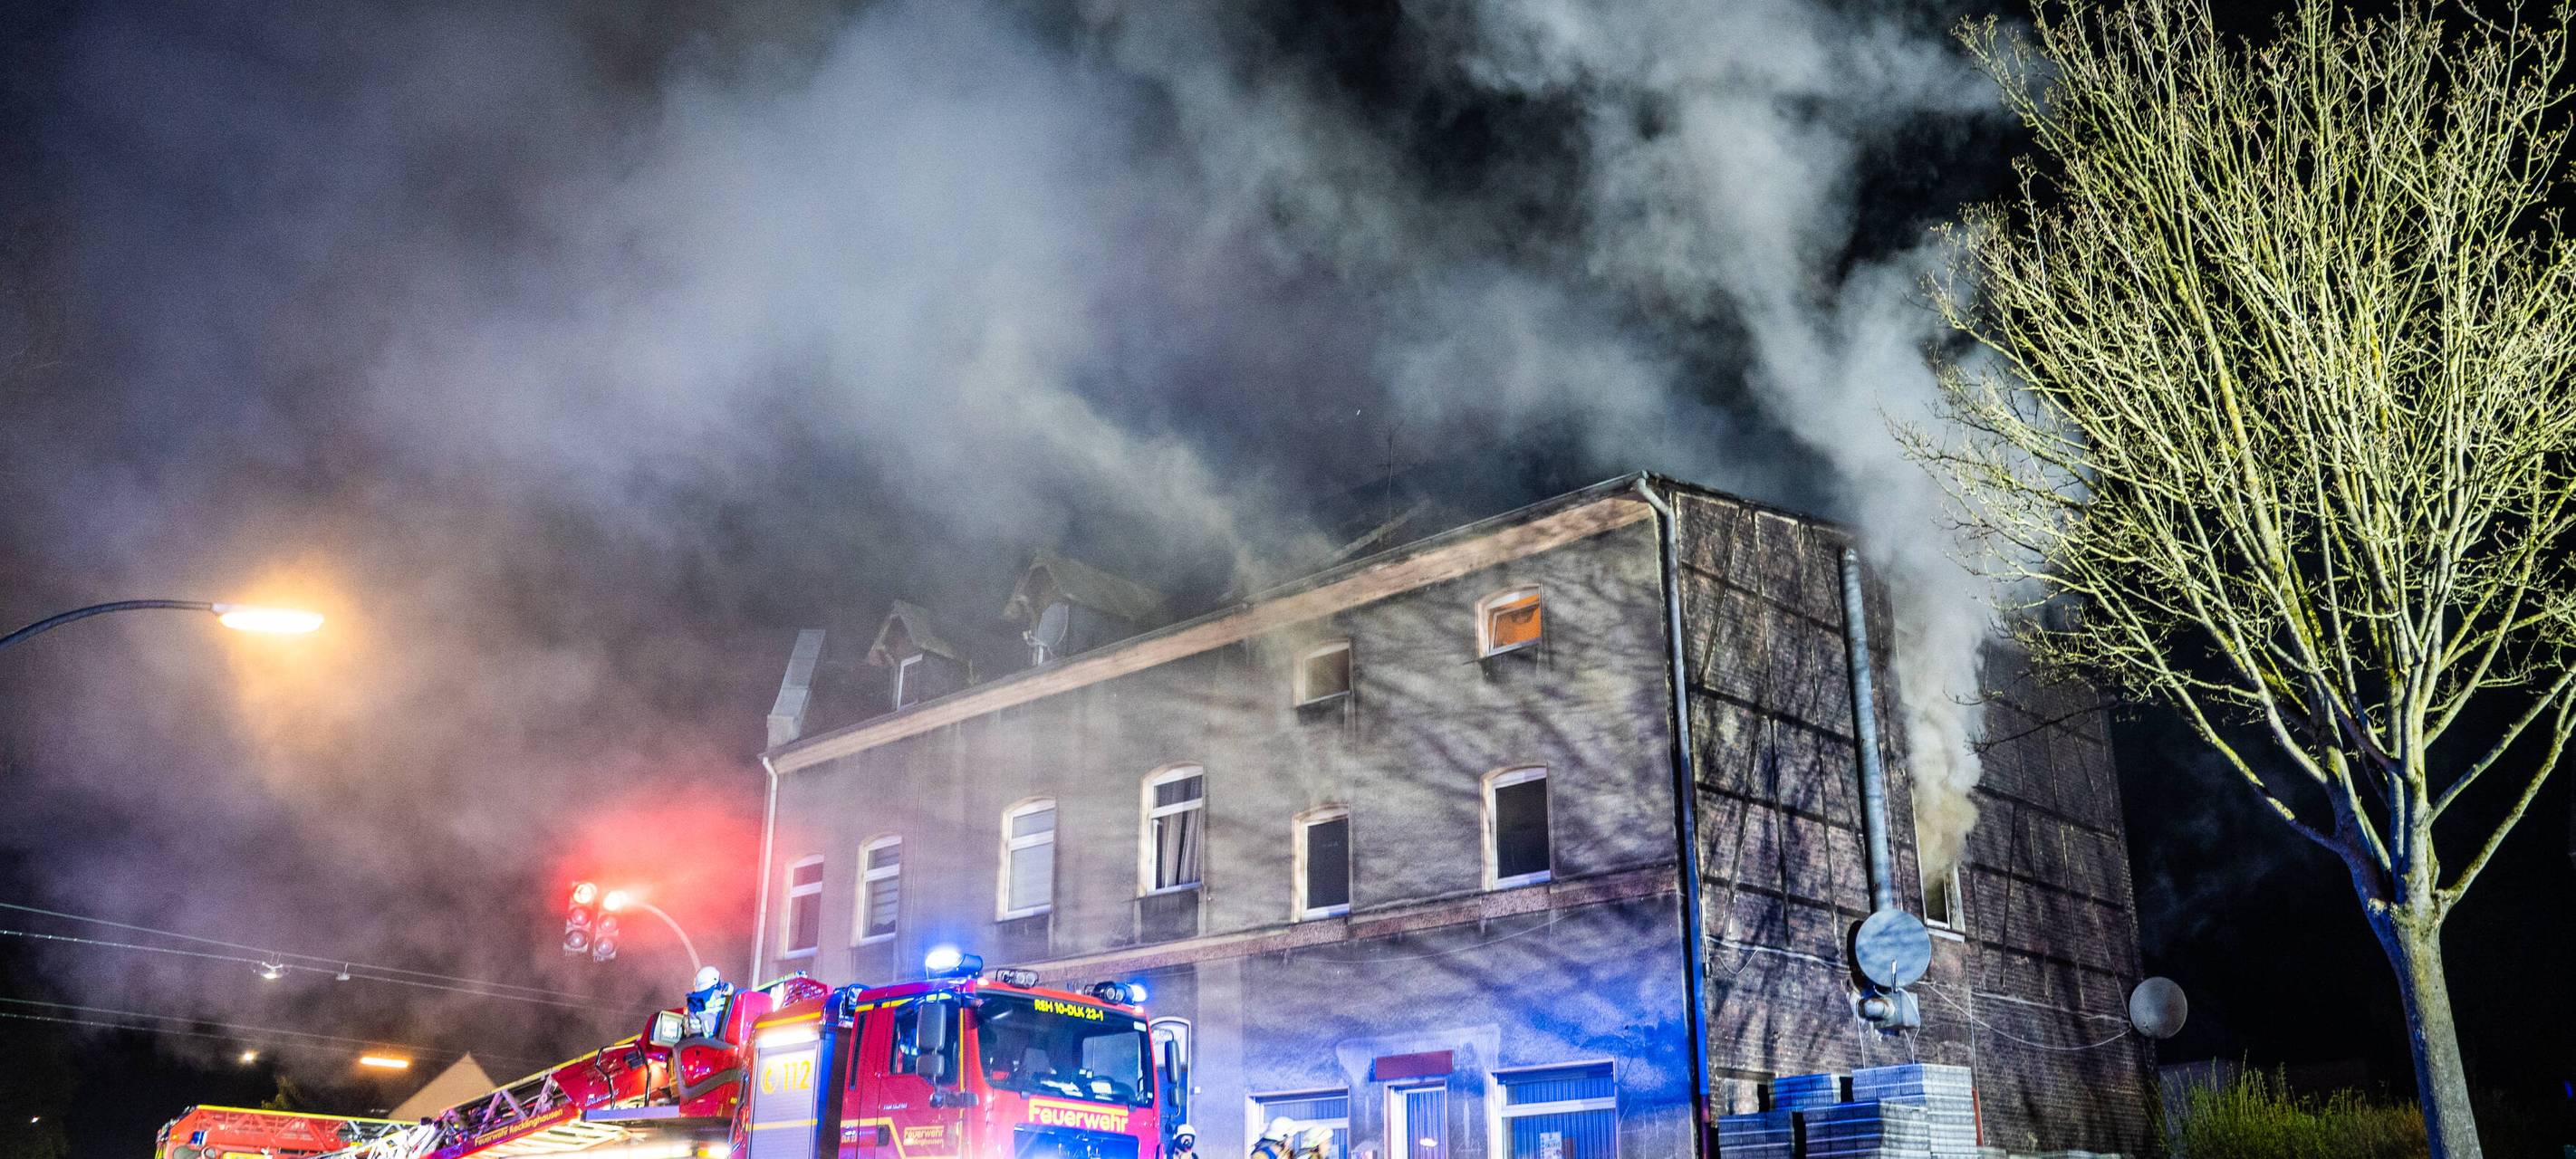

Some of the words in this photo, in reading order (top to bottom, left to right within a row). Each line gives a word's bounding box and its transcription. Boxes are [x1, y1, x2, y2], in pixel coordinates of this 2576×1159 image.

[783, 1060, 812, 1092] 112
[475, 1125, 509, 1147] Feuerwehr
[509, 1108, 563, 1135] Recklinghausen
[1028, 1098, 1129, 1133] Feuerwehr
